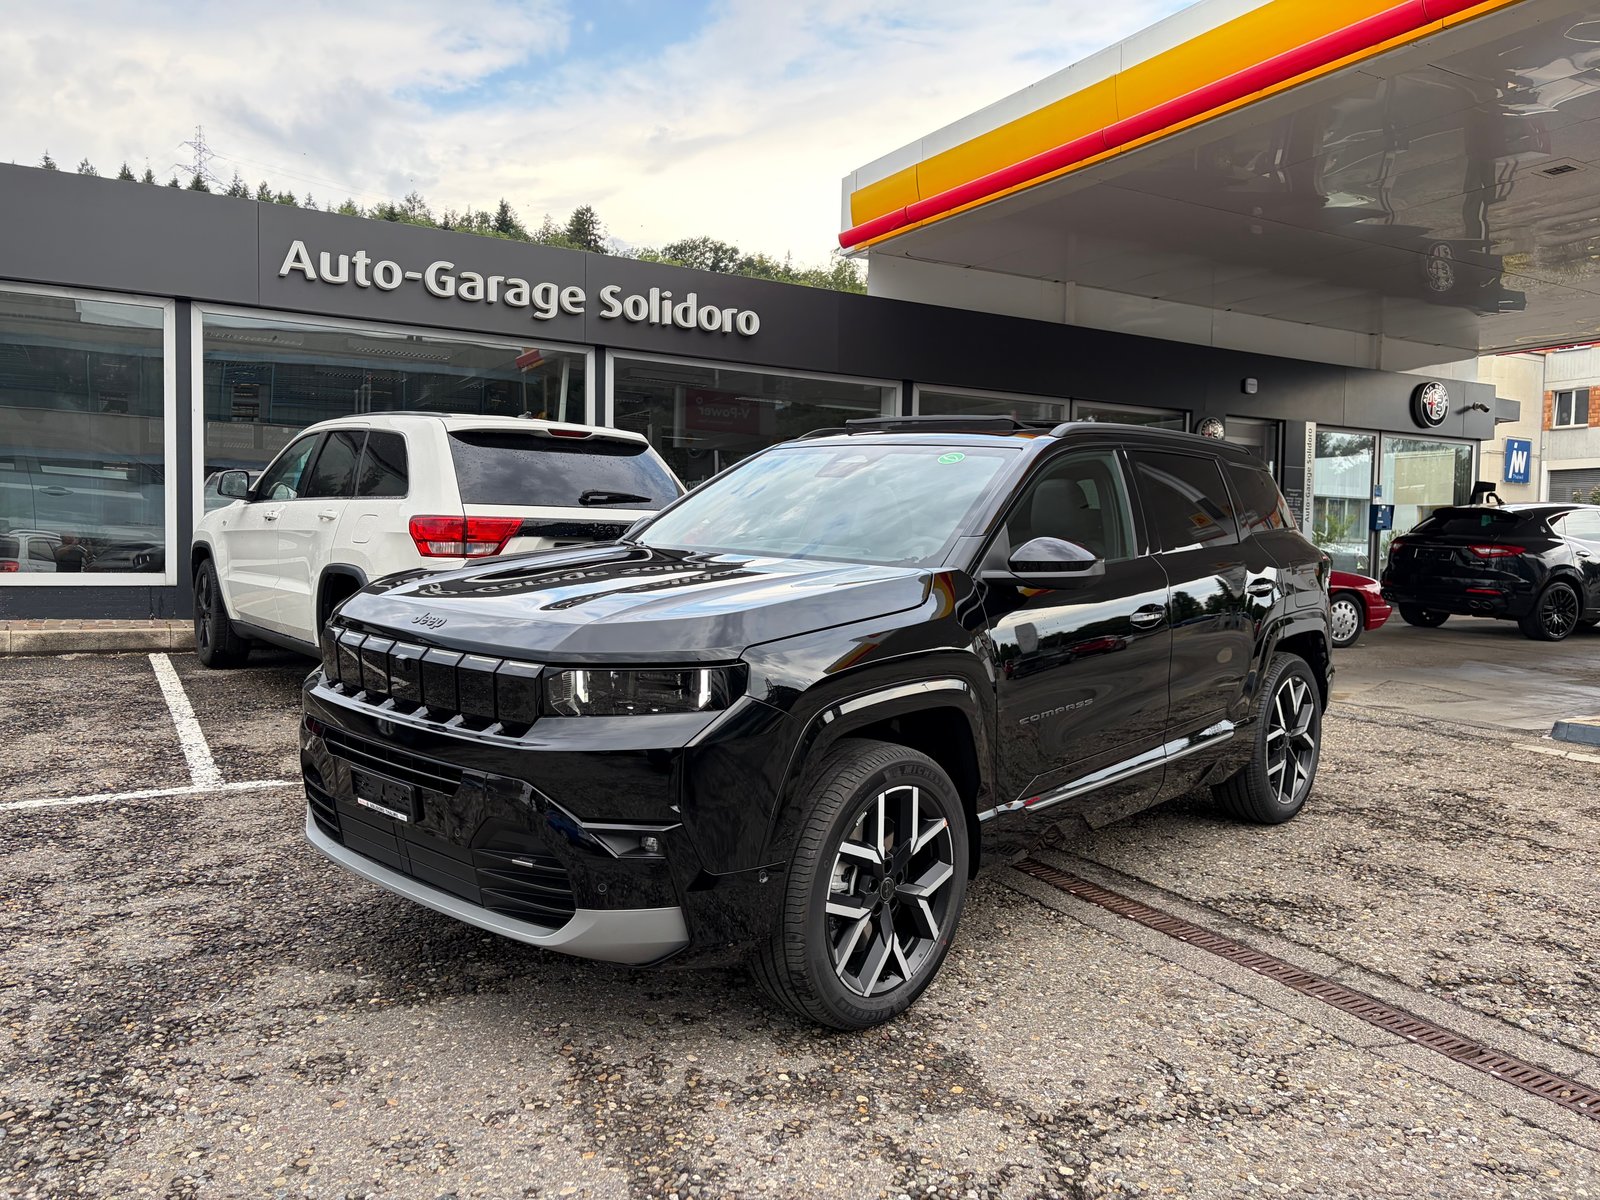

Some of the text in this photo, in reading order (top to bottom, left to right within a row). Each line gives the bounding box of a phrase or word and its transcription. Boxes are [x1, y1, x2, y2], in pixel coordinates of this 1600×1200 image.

[278, 239, 760, 337] Auto-Garage Solidoro
[411, 612, 448, 630] Jeep
[1019, 698, 1094, 725] COMPASS
